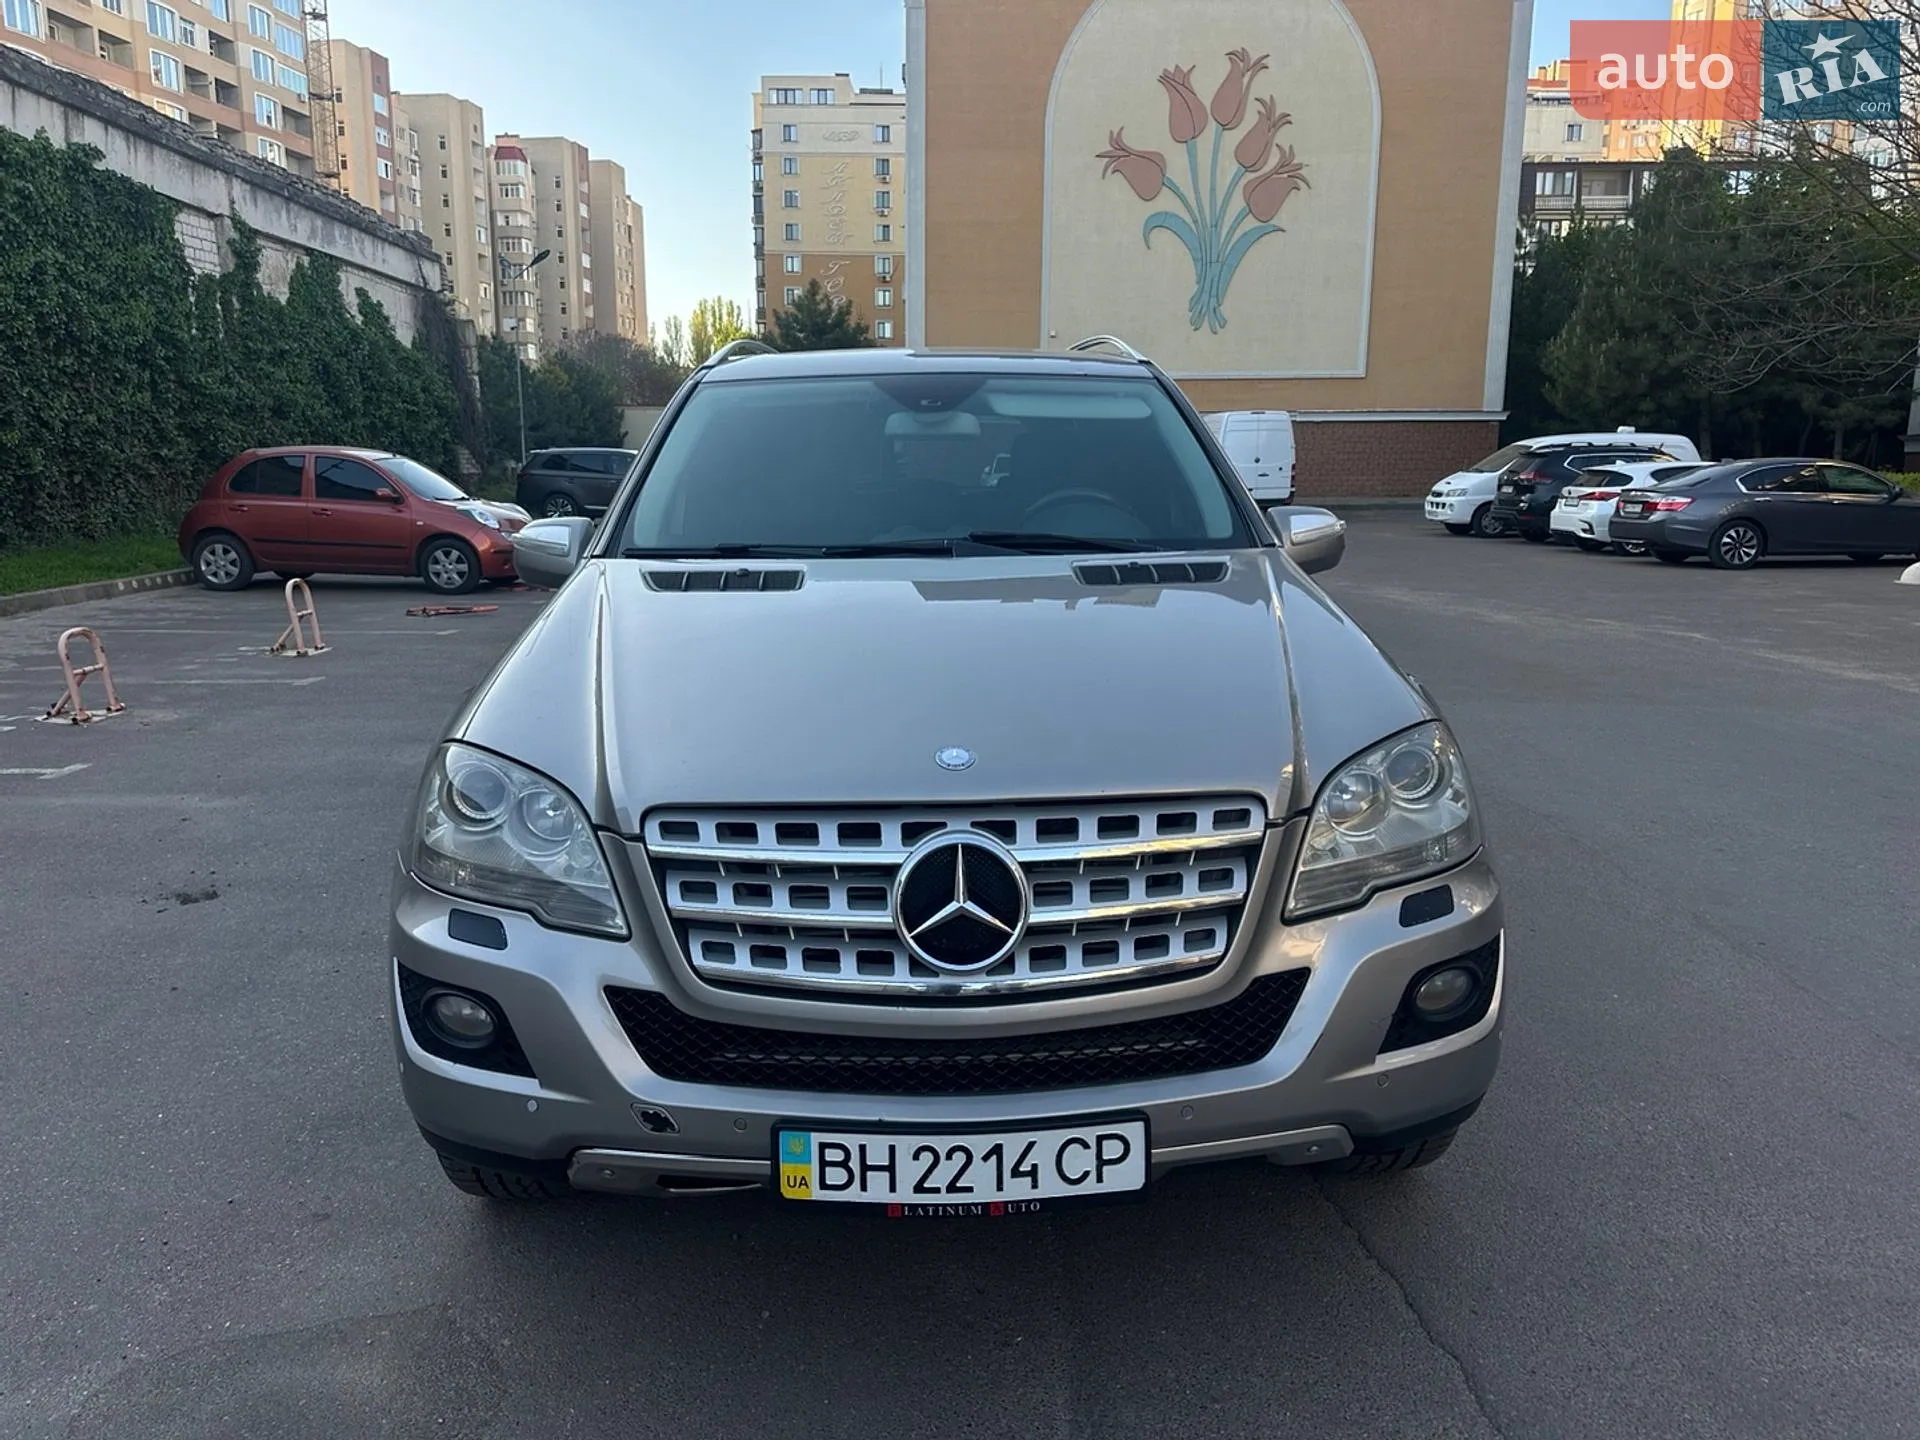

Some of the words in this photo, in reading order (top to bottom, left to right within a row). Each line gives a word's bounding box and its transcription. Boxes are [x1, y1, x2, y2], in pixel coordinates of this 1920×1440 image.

[786, 1175, 809, 1189] UA
[818, 1142, 897, 1193] BH
[911, 1140, 1039, 1194] 2214
[1055, 1132, 1131, 1186] CP
